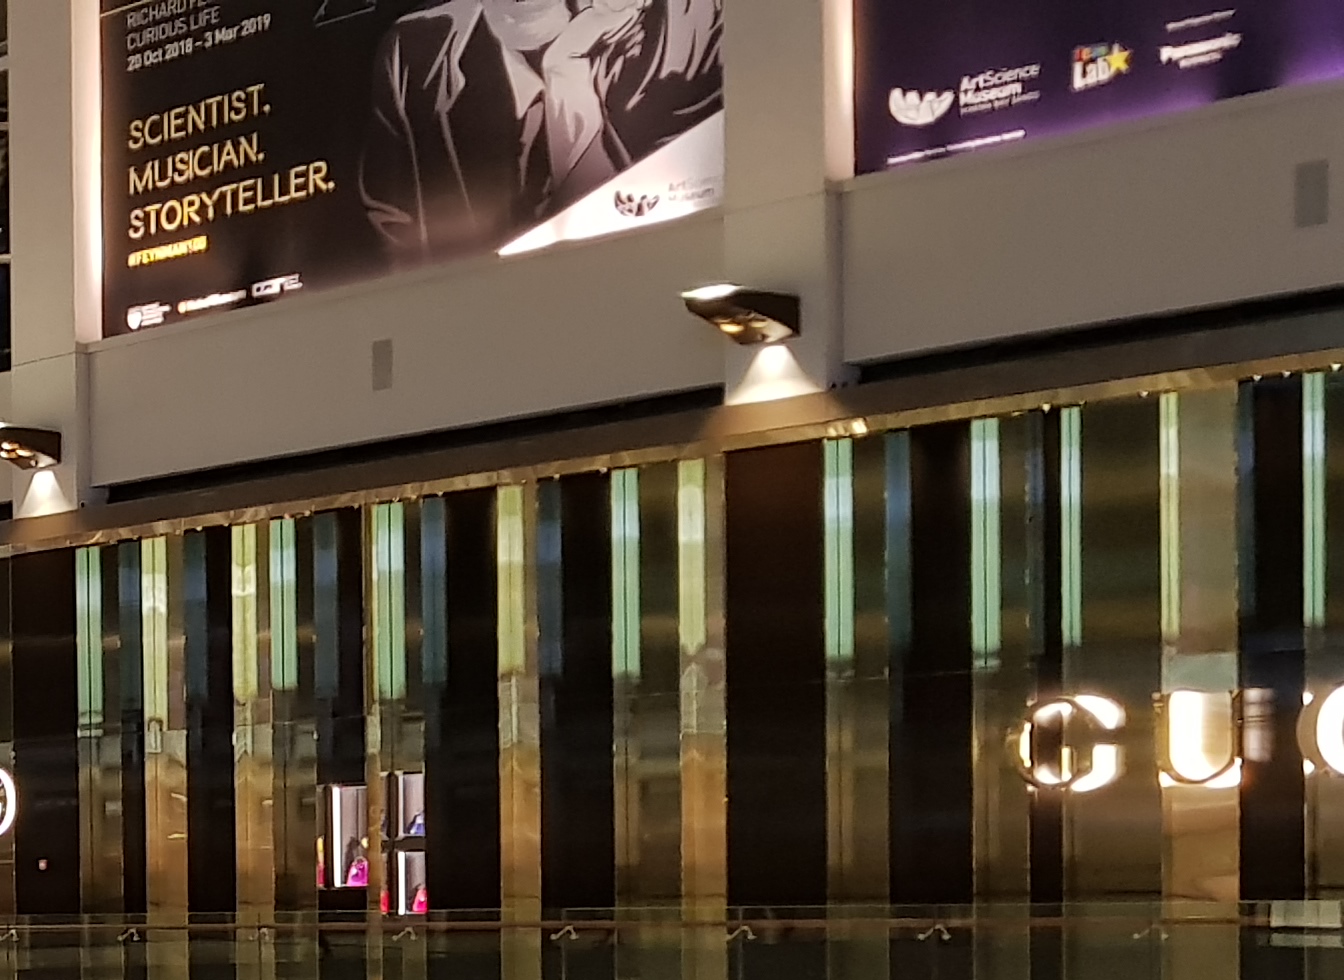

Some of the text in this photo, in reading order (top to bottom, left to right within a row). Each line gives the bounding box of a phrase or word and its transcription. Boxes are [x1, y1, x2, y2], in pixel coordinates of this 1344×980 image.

[126, 17, 187, 50] CURIOUS
[189, 6, 221, 31] LIFE
[164, 37, 193, 60] 2018
[240, 13, 272, 36] 2019
[961, 63, 1041, 92] ArtScience
[128, 83, 272, 150] SCIENTIST.
[128, 131, 266, 196] MUSICIAN.
[128, 159, 337, 240] STORYTELLER.
